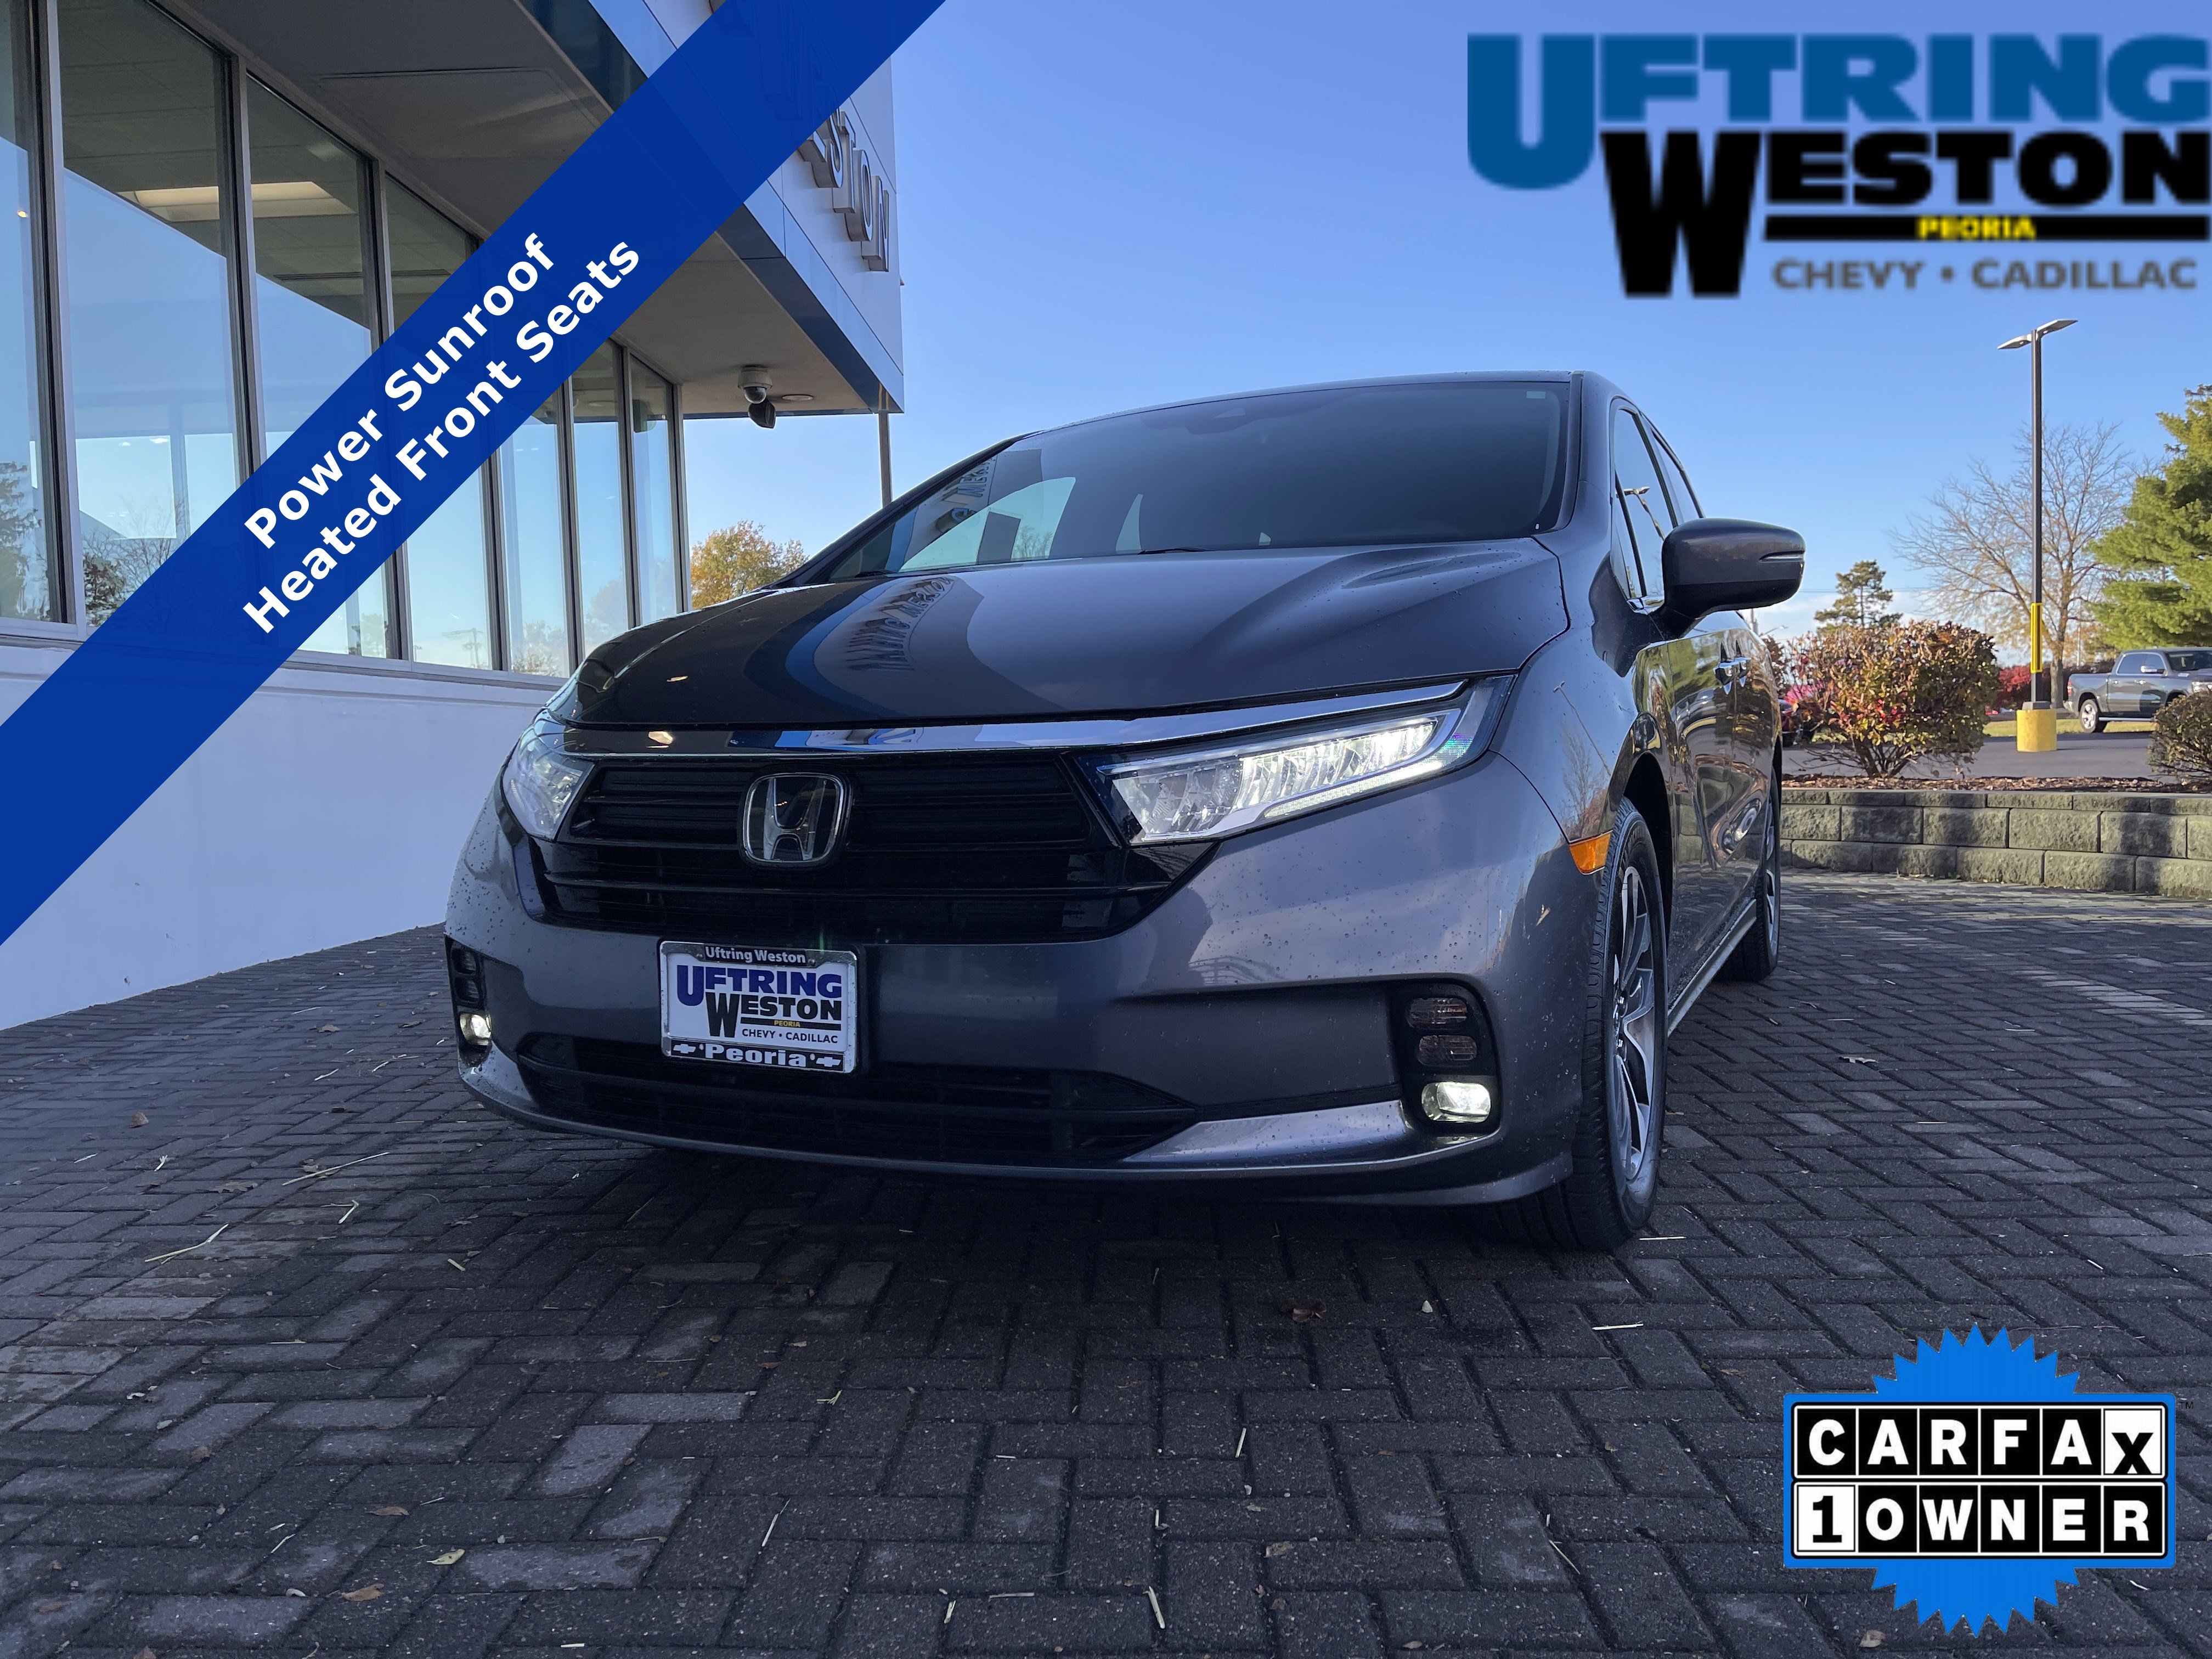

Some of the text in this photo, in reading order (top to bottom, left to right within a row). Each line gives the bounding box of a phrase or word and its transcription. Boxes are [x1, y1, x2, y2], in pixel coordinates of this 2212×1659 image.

[706, 946, 806, 964] Uftring Weston
[677, 964, 842, 1006] UFTRING
[706, 991, 842, 1038] WESTON
[774, 1019, 801, 1028] PEORIA
[742, 1028, 838, 1043] CHEVY CADILLAC
[705, 1043, 807, 1068] Peoria
